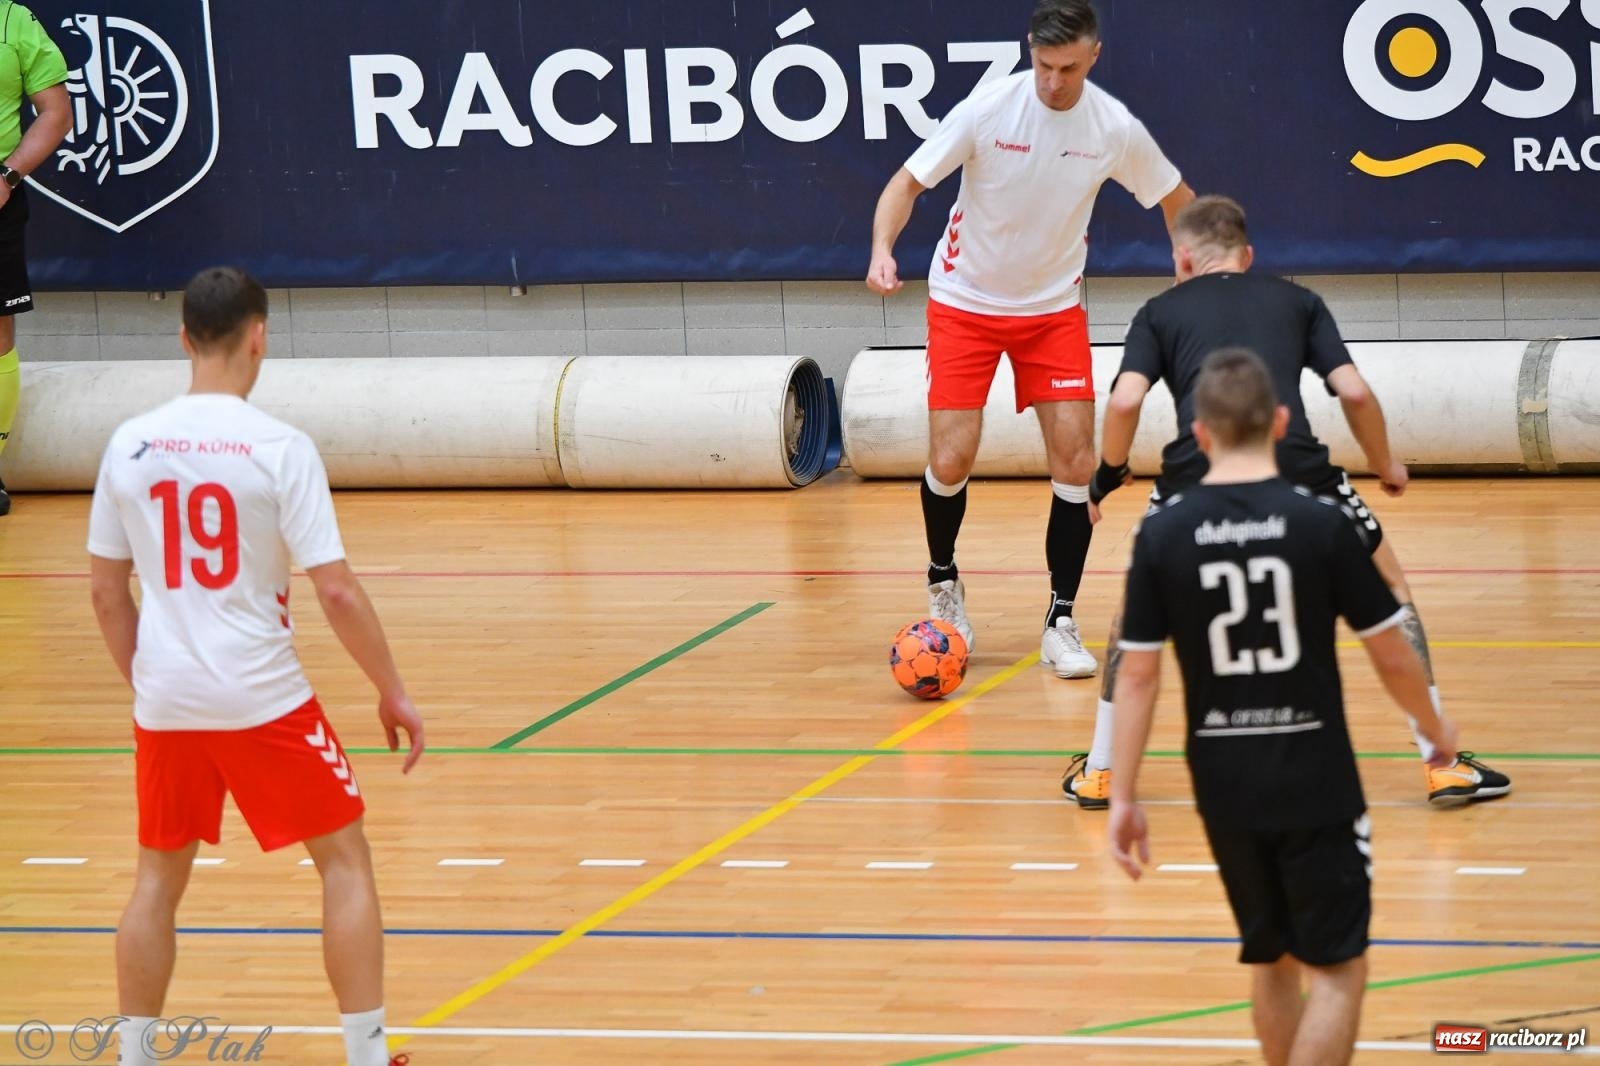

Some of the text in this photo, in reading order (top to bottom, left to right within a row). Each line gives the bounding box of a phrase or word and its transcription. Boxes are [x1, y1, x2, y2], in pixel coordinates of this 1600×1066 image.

[995, 139, 1031, 153] hummel
[151, 438, 191, 453] PRD
[150, 480, 239, 590] 19
[1199, 556, 1300, 676] 23
